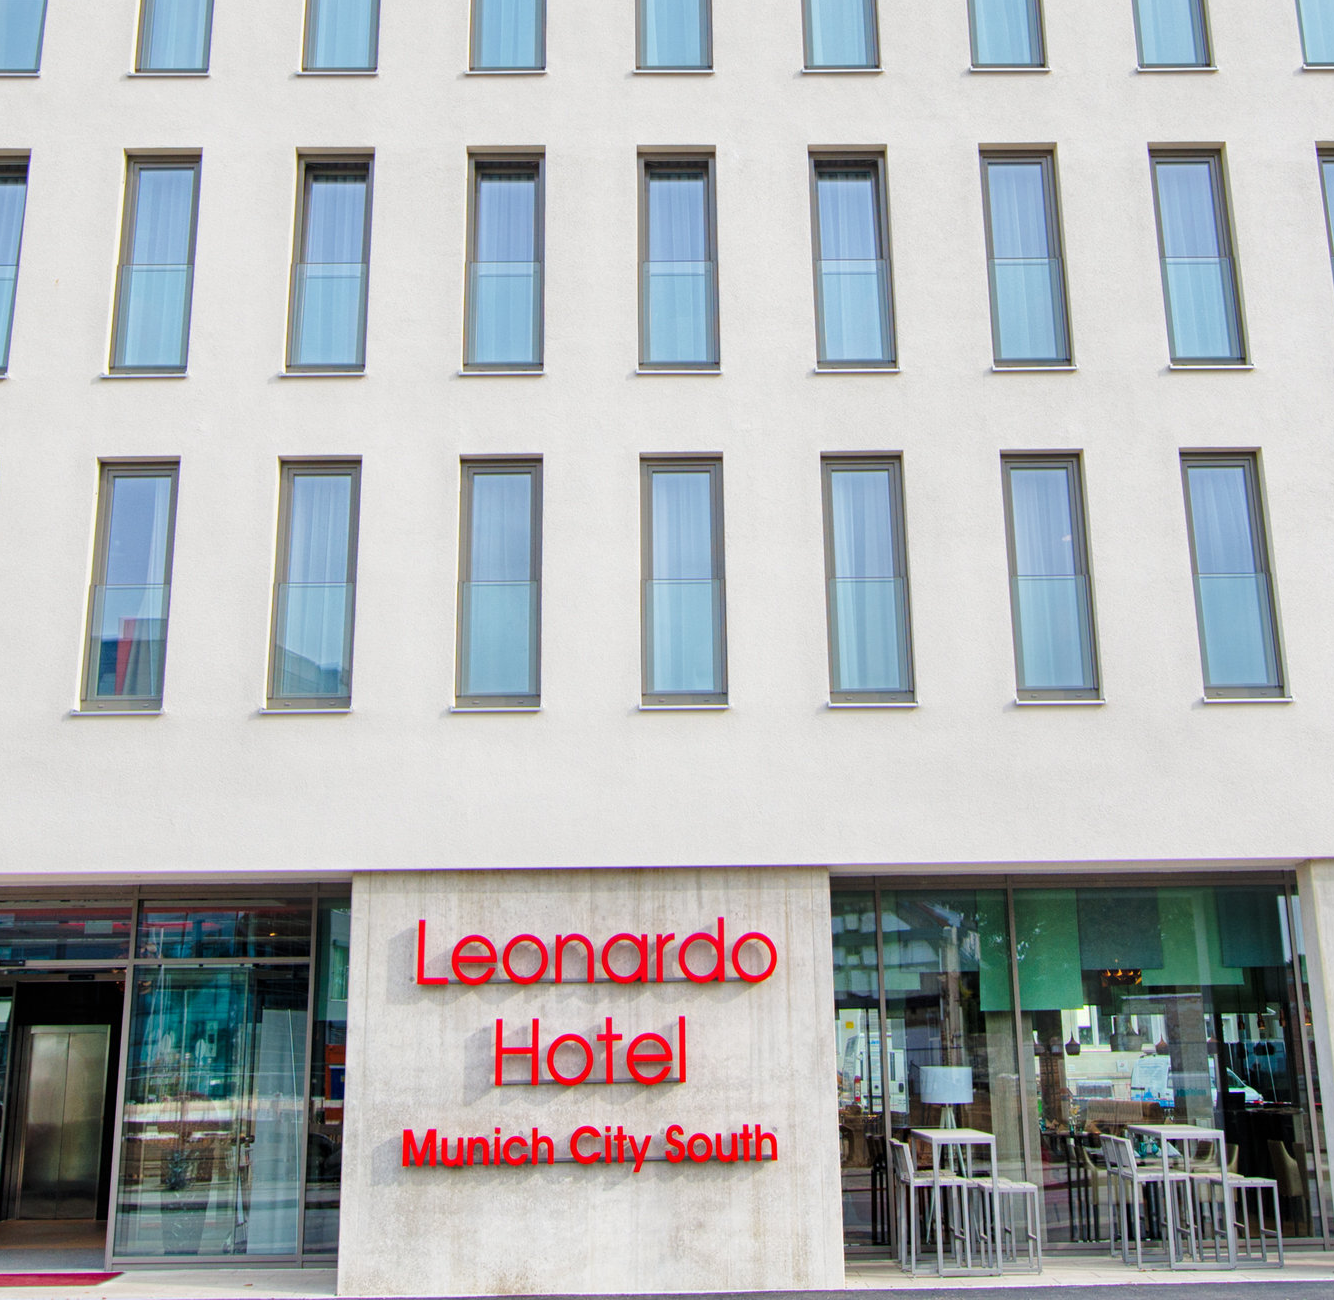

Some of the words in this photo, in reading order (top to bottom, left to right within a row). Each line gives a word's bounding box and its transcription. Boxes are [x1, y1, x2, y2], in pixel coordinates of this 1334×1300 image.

[416, 917, 778, 986] Leonardo
[494, 1016, 687, 1087] Hotel
[401, 1127, 555, 1168] Munich
[569, 1125, 653, 1174] City
[664, 1124, 778, 1164] South
